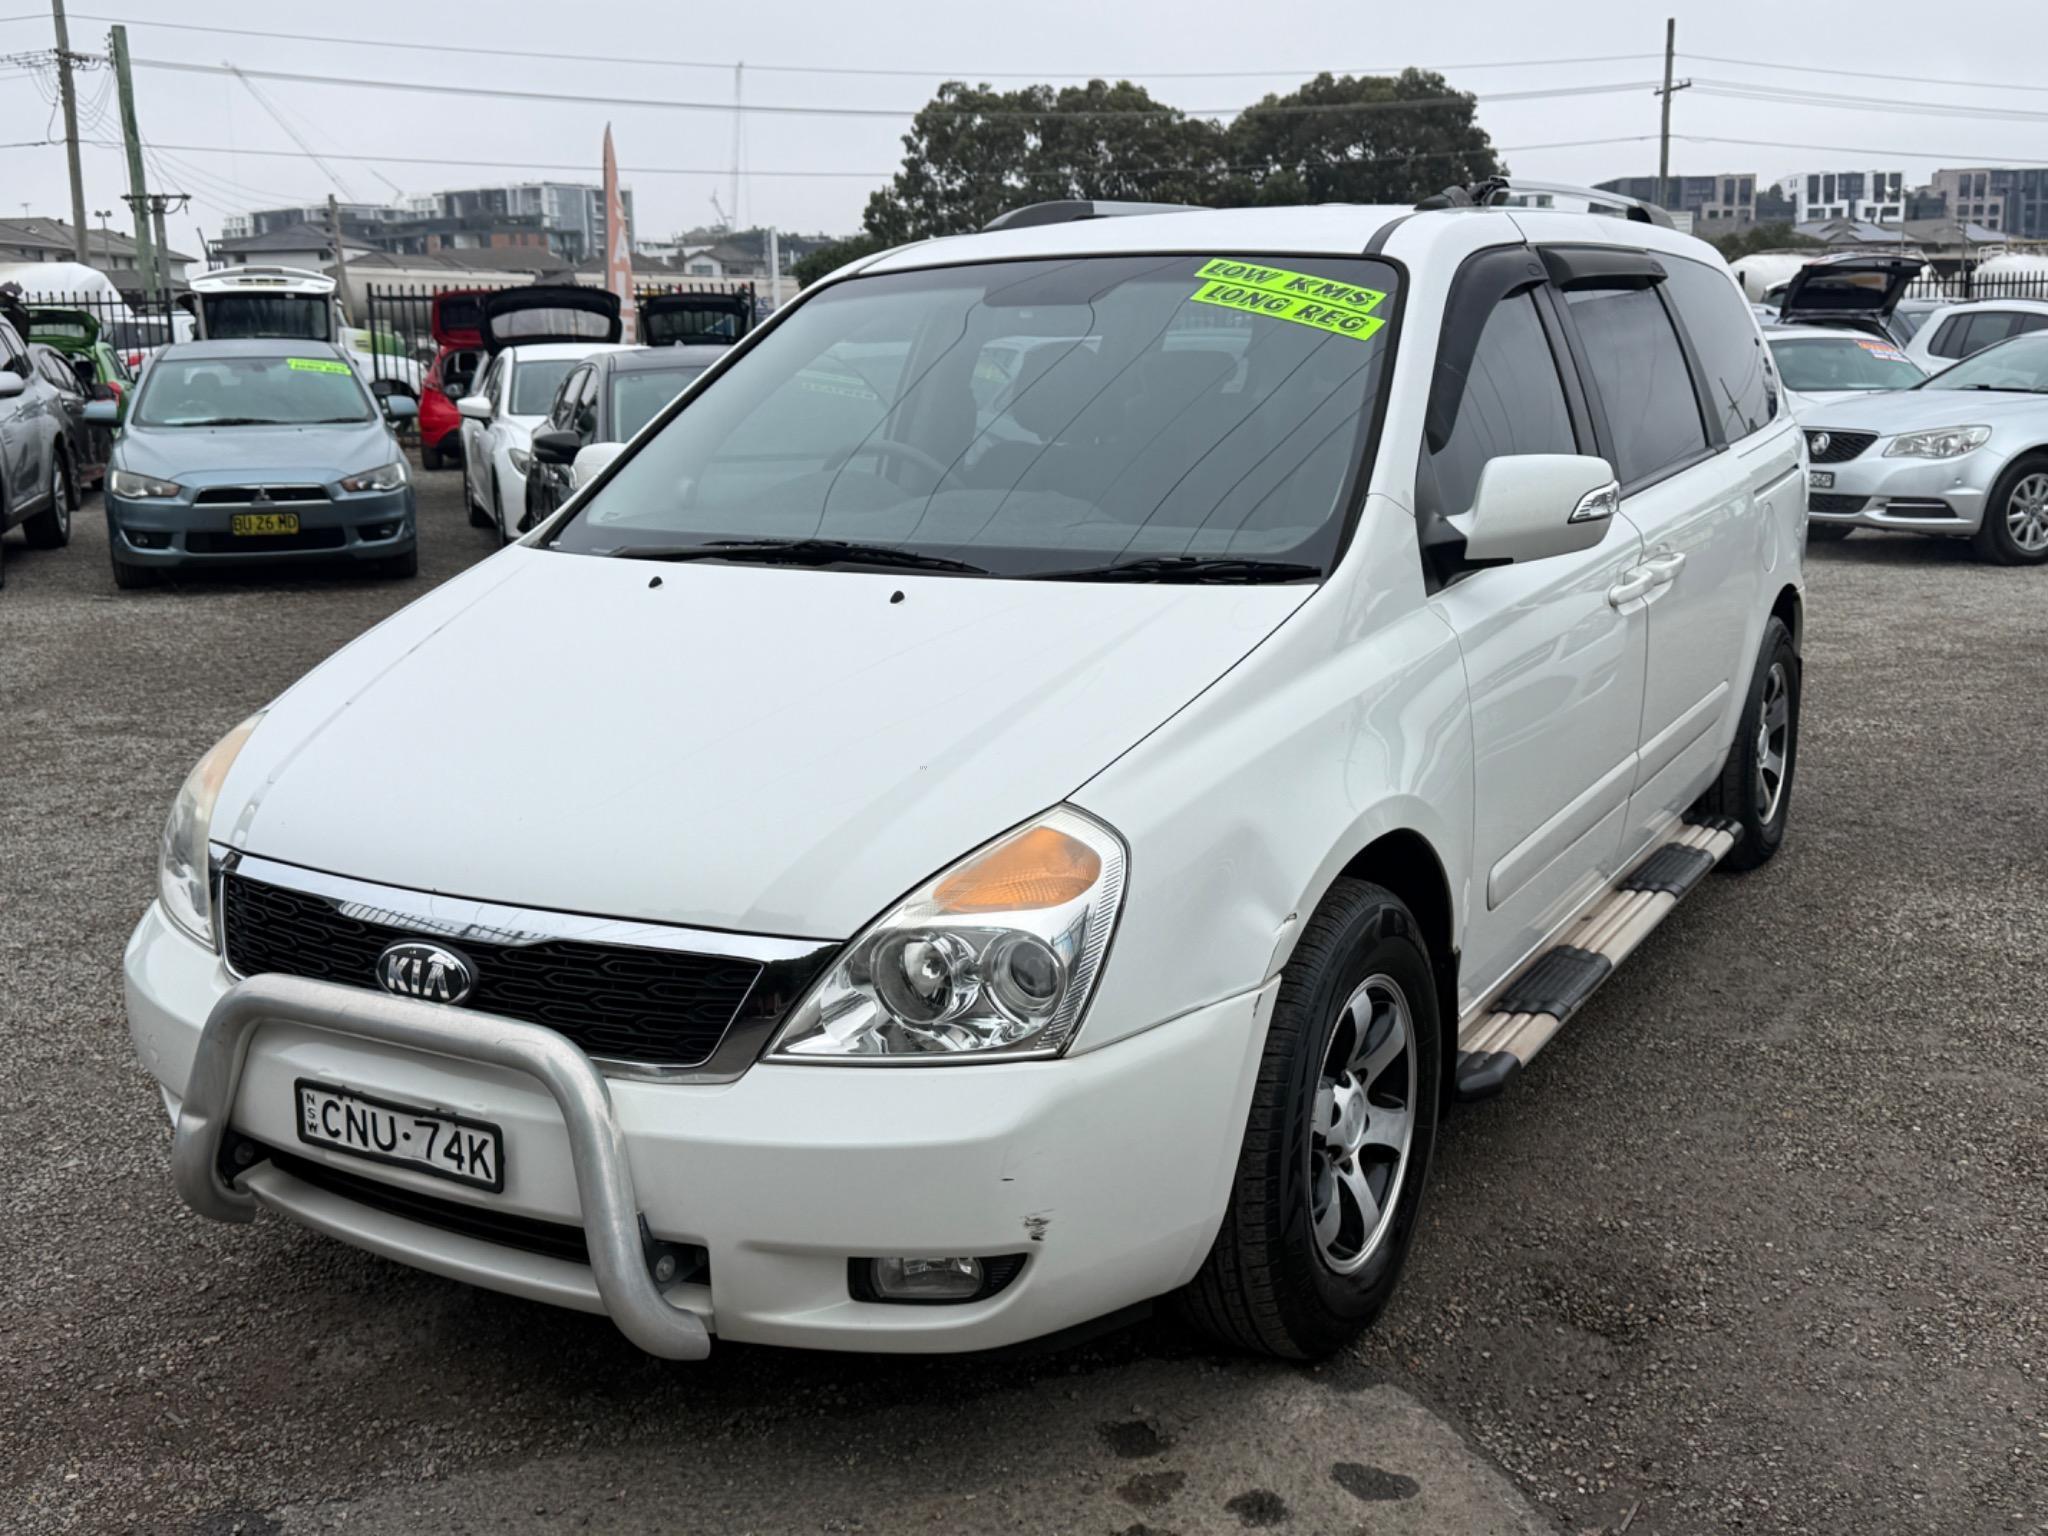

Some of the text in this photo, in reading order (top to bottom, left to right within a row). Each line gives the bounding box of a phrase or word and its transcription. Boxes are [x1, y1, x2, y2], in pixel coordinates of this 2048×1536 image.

[1205, 262, 1377, 307] LOW KMS
[1203, 285, 1370, 332] LONG REG
[387, 951, 456, 1000] KIA
